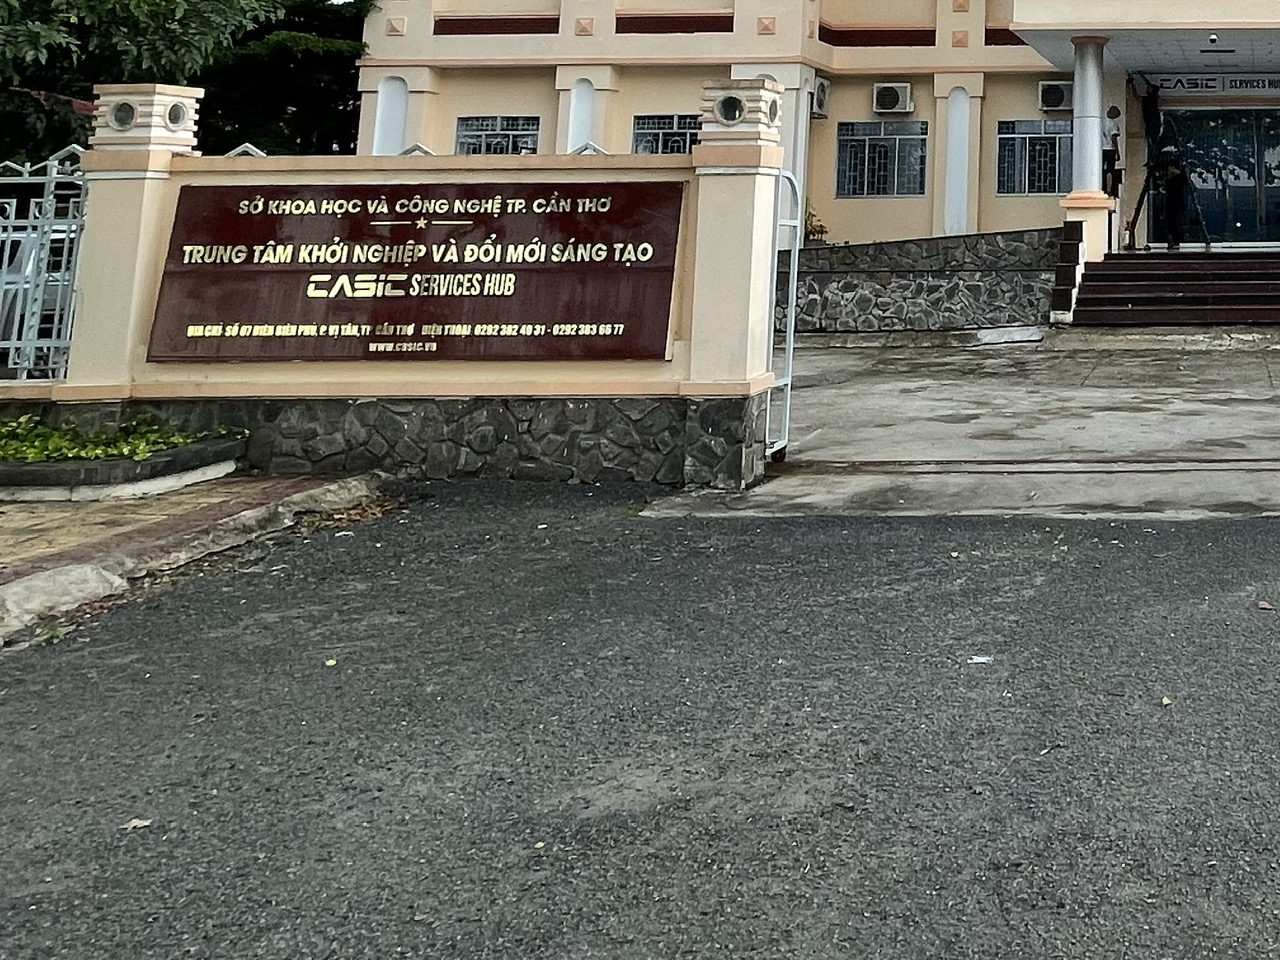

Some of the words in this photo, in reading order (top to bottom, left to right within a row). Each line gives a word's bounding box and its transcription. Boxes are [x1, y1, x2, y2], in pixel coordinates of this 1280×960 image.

[1160, 78, 1217, 90] CASIC
[1229, 79, 1266, 90] SERVICES
[239, 195, 264, 214] SỞ
[268, 199, 316, 215] KHOA
[320, 199, 363, 218] HỌC
[366, 195, 389, 214] VÀ
[395, 195, 449, 214] CÔNG
[453, 195, 502, 218] NGHỆ
[506, 199, 527, 214] TP.
[532, 191, 571, 213] CẦN
[577, 197, 612, 213] THƠ
[182, 245, 248, 264] TRUNG
[253, 241, 294, 264] TÂM
[298, 237, 349, 264] KHỞI
[352, 240, 427, 267] NGHIỆP
[431, 238, 458, 263] VÀ
[464, 234, 502, 263] ĐỔI
[505, 237, 547, 263] MỚI
[551, 238, 608, 262] SÁNG
[613, 242, 653, 267] TẠO
[409, 273, 482, 297] SERVICES
[483, 273, 516, 296] HUB
[552, 324, 577, 336] 0292
[598, 324, 612, 336] 66
[613, 324, 625, 335] 77
[368, 342, 437, 352] www.casic.vn
